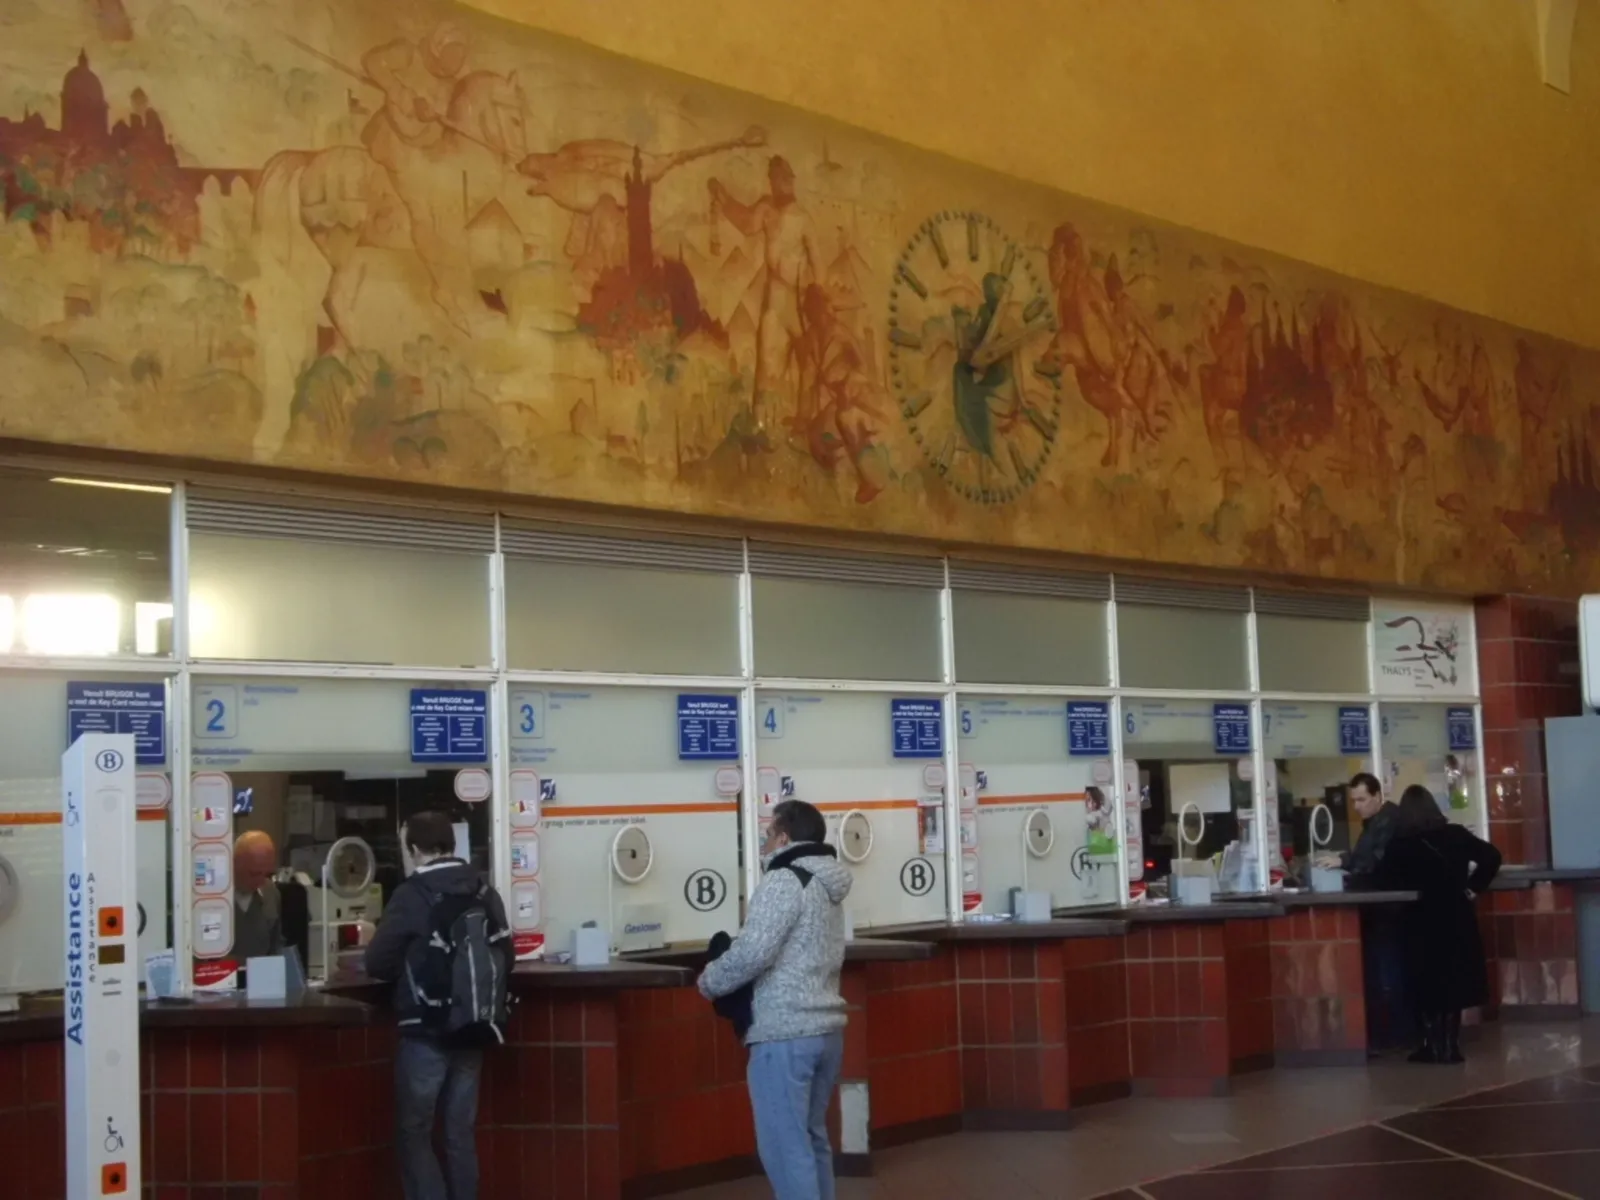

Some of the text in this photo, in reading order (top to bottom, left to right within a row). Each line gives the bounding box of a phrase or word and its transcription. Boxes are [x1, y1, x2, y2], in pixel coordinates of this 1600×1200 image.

[1381, 665, 1412, 676] THALYS
[206, 699, 225, 731] 2
[520, 704, 535, 733] 3
[764, 708, 777, 733] 4
[962, 709, 972, 734] 5
[1126, 712, 1135, 734] 6
[1263, 714, 1271, 734] 7
[695, 876, 716, 905] B
[910, 864, 926, 891] B
[66, 872, 83, 1045] Assistance
